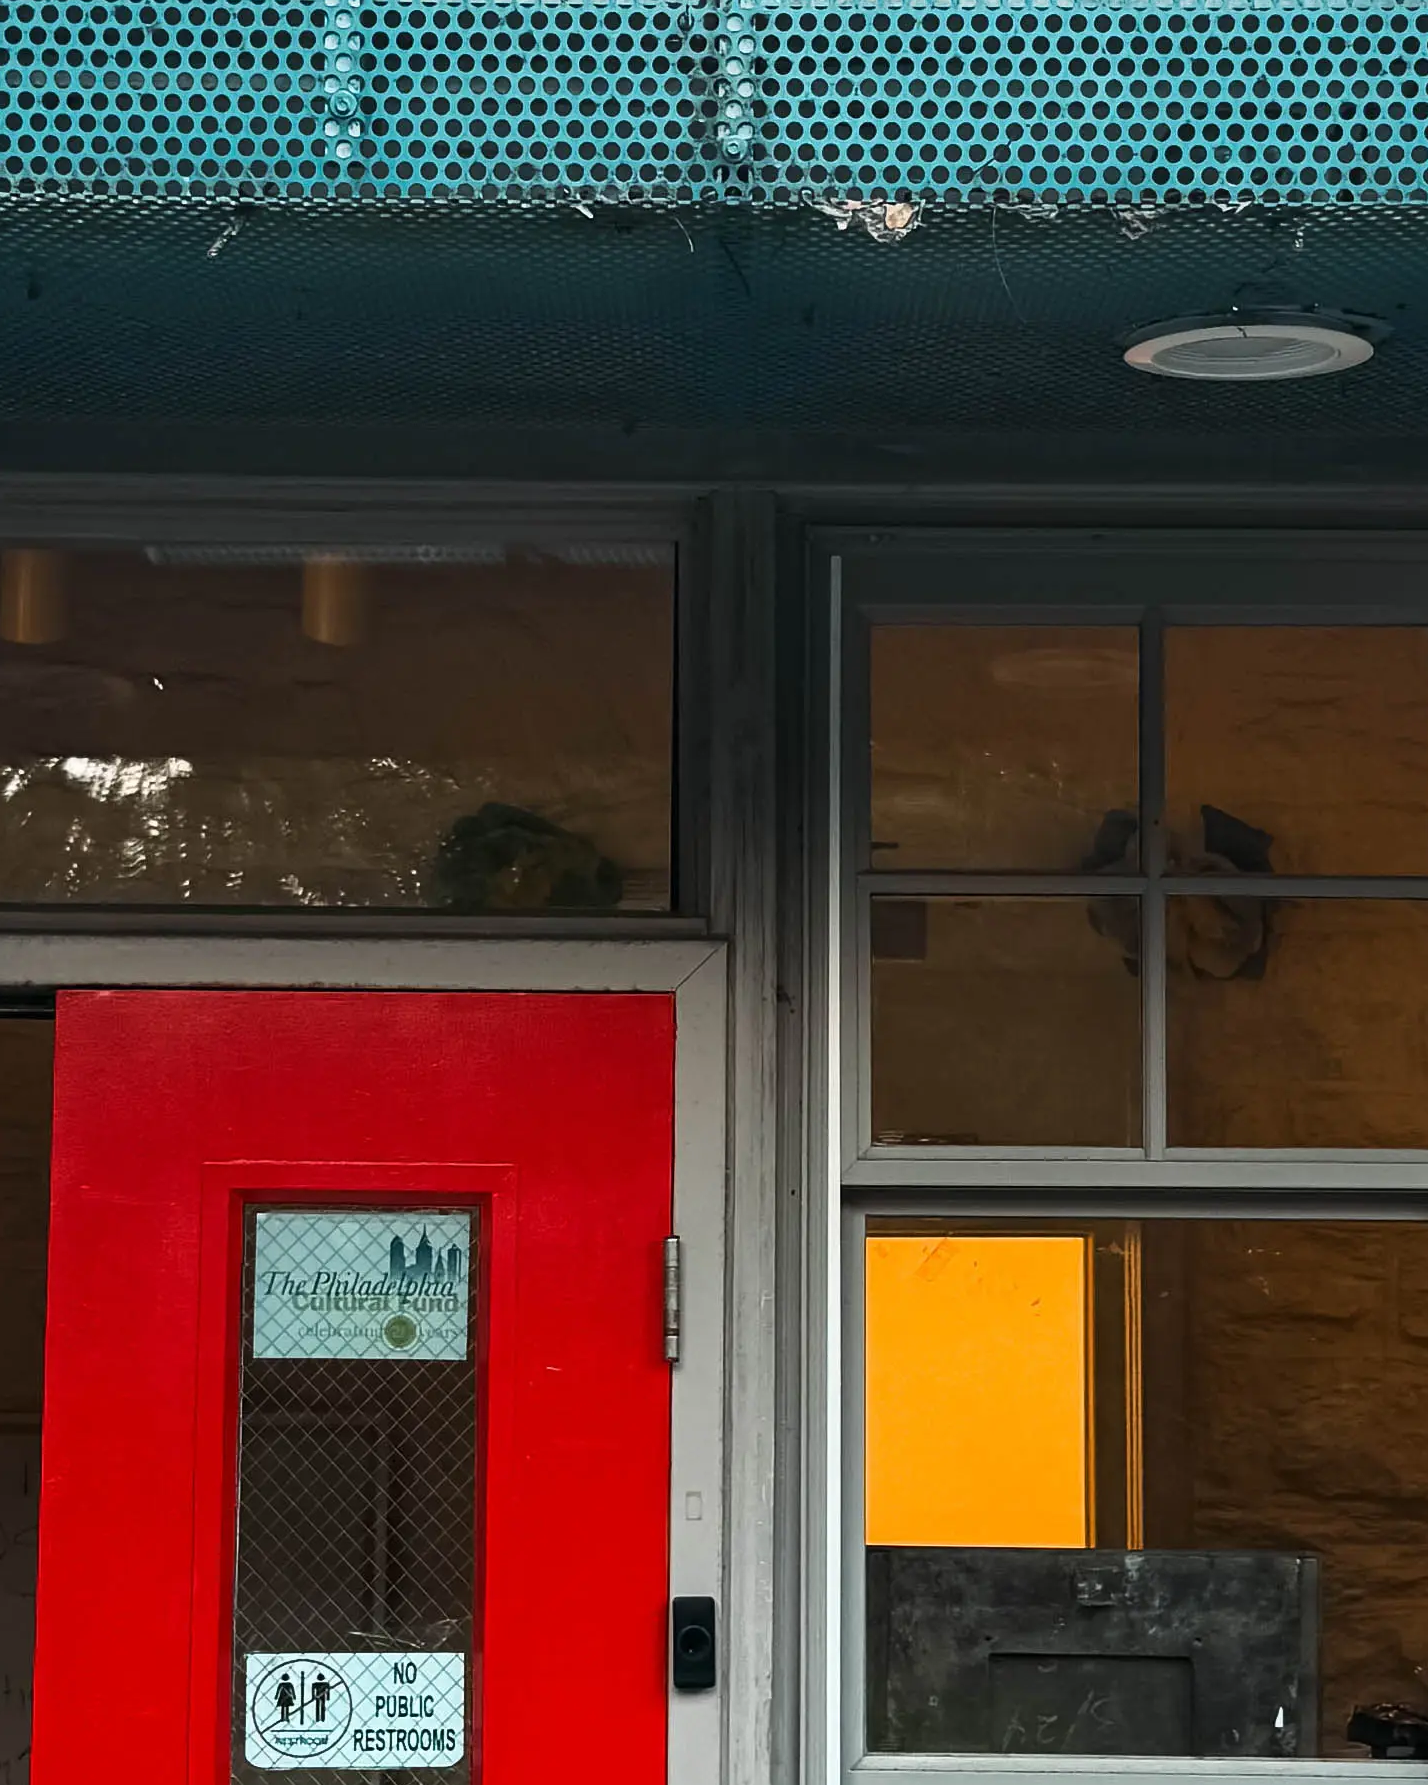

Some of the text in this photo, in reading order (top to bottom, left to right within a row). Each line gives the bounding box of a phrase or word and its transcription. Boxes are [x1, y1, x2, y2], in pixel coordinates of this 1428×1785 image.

[260, 1270, 455, 1303] The Philadelphia
[291, 1291, 460, 1313] Cultural Fund
[394, 1661, 417, 1685] NO
[375, 1695, 434, 1718] PUBLIC
[353, 1728, 456, 1752] RESTROOMS
